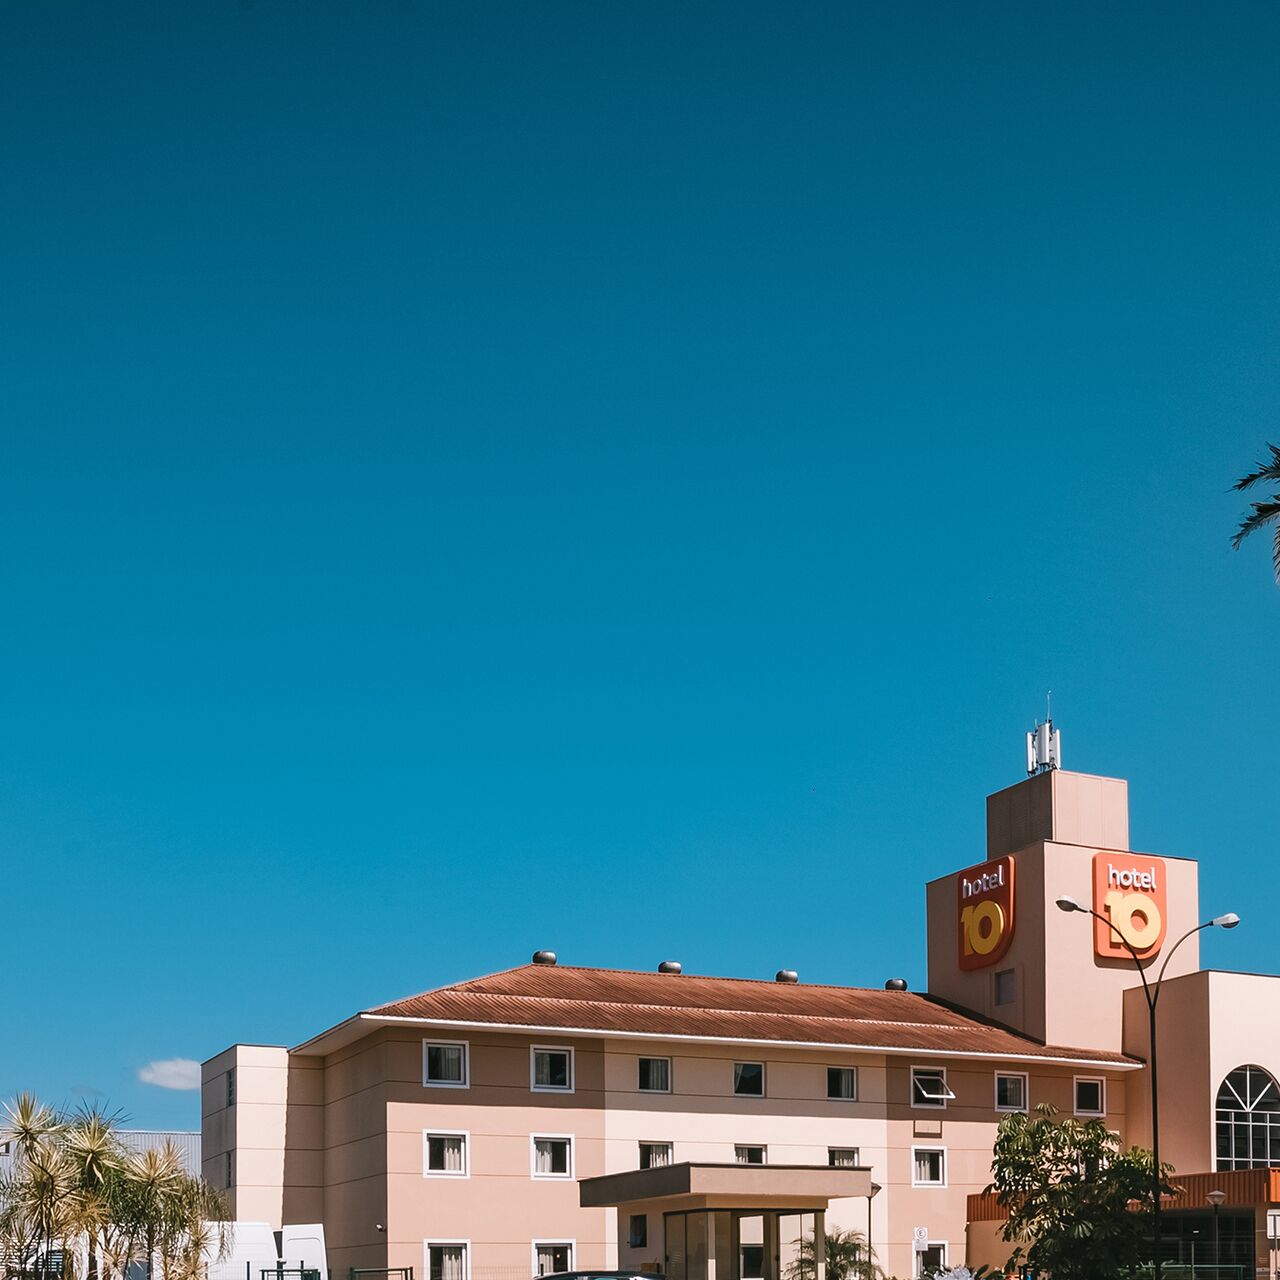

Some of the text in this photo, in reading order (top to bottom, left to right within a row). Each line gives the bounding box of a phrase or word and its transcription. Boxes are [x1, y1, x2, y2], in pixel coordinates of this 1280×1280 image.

[962, 864, 1004, 899] hotel
[1108, 863, 1157, 890] hotel
[960, 900, 1005, 956] 10
[1104, 890, 1162, 949] 10
